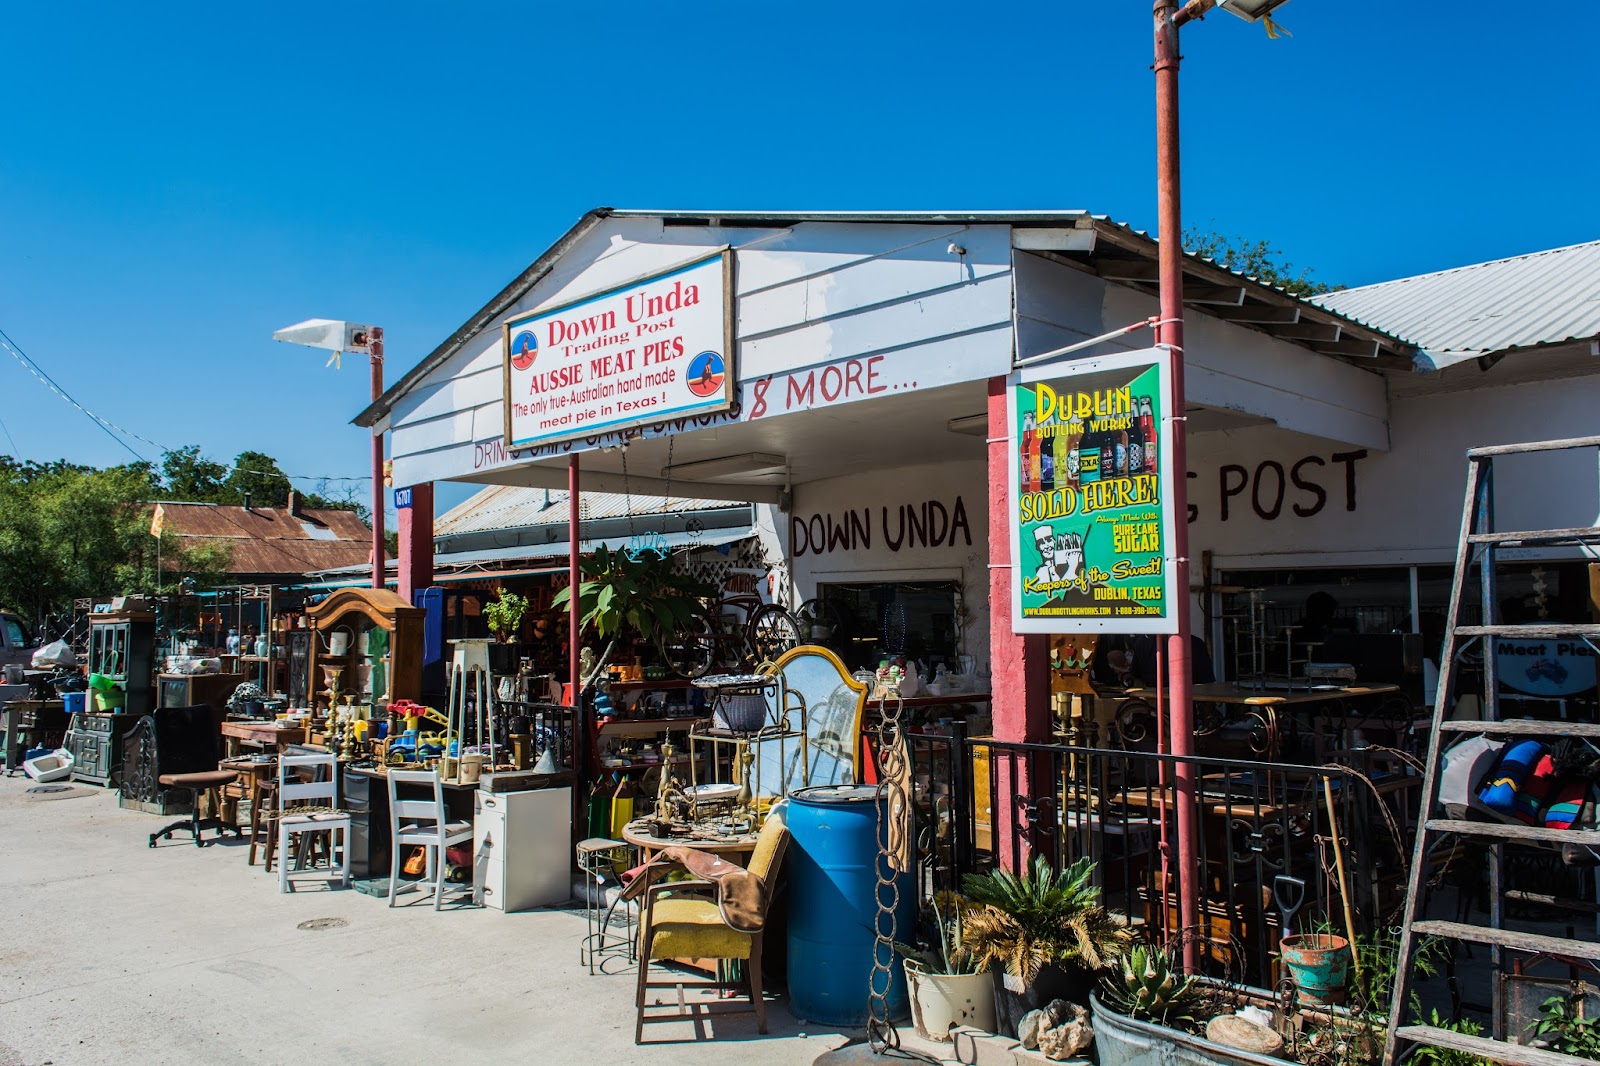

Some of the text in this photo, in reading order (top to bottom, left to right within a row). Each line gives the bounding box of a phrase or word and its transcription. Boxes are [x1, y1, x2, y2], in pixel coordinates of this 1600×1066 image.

[547, 281, 700, 348] Down Unda
[561, 316, 676, 358] Trading Post
[529, 336, 685, 395] AUSSIE MEAT PIES
[530, 397, 548, 415] only
[617, 373, 642, 394] hand
[644, 366, 676, 388] made
[539, 413, 572, 429] meat
[575, 408, 597, 424] pie
[600, 404, 612, 416] in
[617, 394, 658, 412] Texas
[1035, 416, 1132, 439] BOTTLING WORKS
[793, 508, 870, 557] DOWN
[883, 496, 972, 552] UNDA
[1220, 450, 1368, 522] POST
[1020, 487, 1076, 524] SOLD
[1081, 473, 1160, 514] HERE!
[1095, 512, 1158, 525] Always Made With
[1113, 522, 1158, 536] PURE CANE
[1114, 534, 1160, 553] SUGAR
[1023, 557, 1162, 597] Keepers of the Sweet!
[1094, 586, 1161, 601] DUBLIN, TEXAS
[1024, 606, 1111, 616] WWW.DUBLINBOTTLINGWORKS.COM
[1498, 643, 1547, 656] Meat
